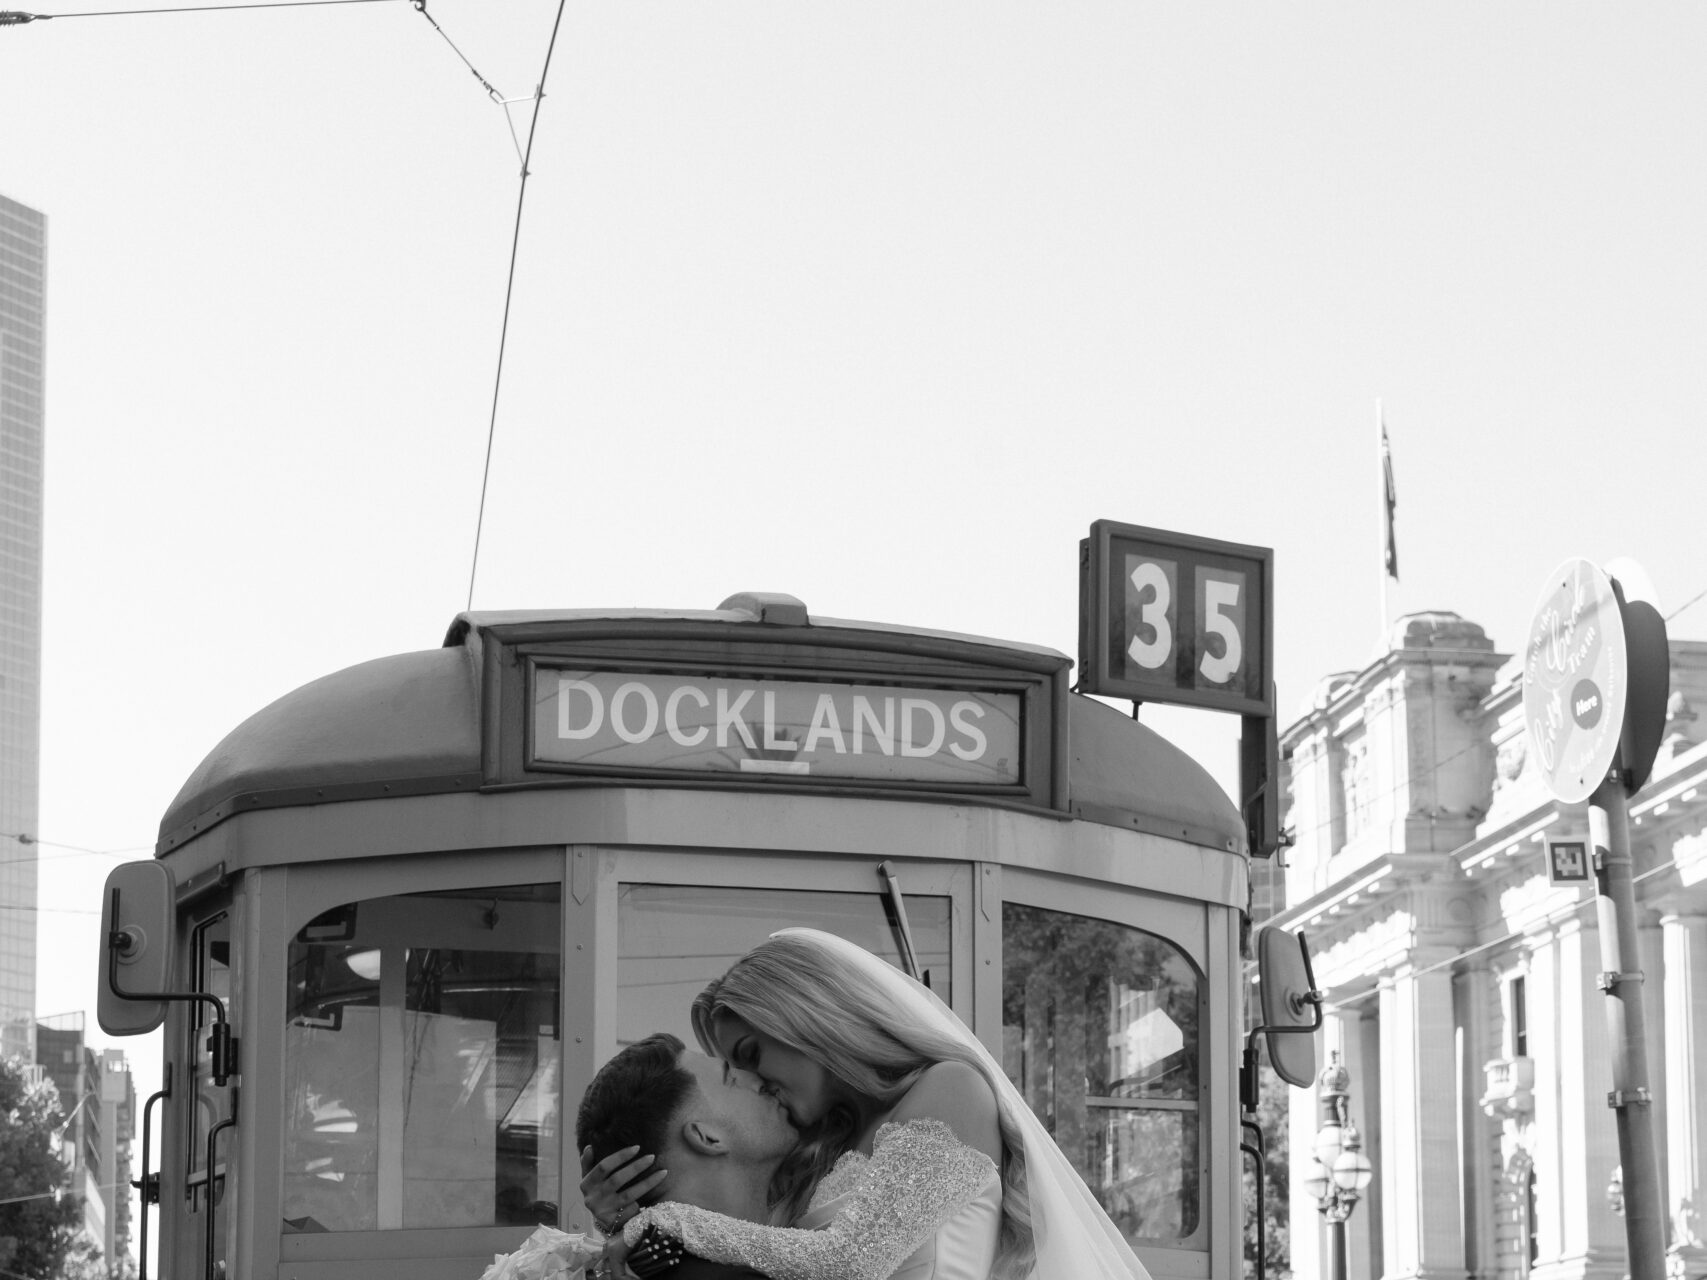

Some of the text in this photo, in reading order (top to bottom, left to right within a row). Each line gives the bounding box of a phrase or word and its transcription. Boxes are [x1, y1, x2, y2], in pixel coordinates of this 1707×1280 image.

[1567, 626, 1596, 674] Tram
[558, 679, 988, 762] DOCKLANDS
[1576, 695, 1598, 716] Here
